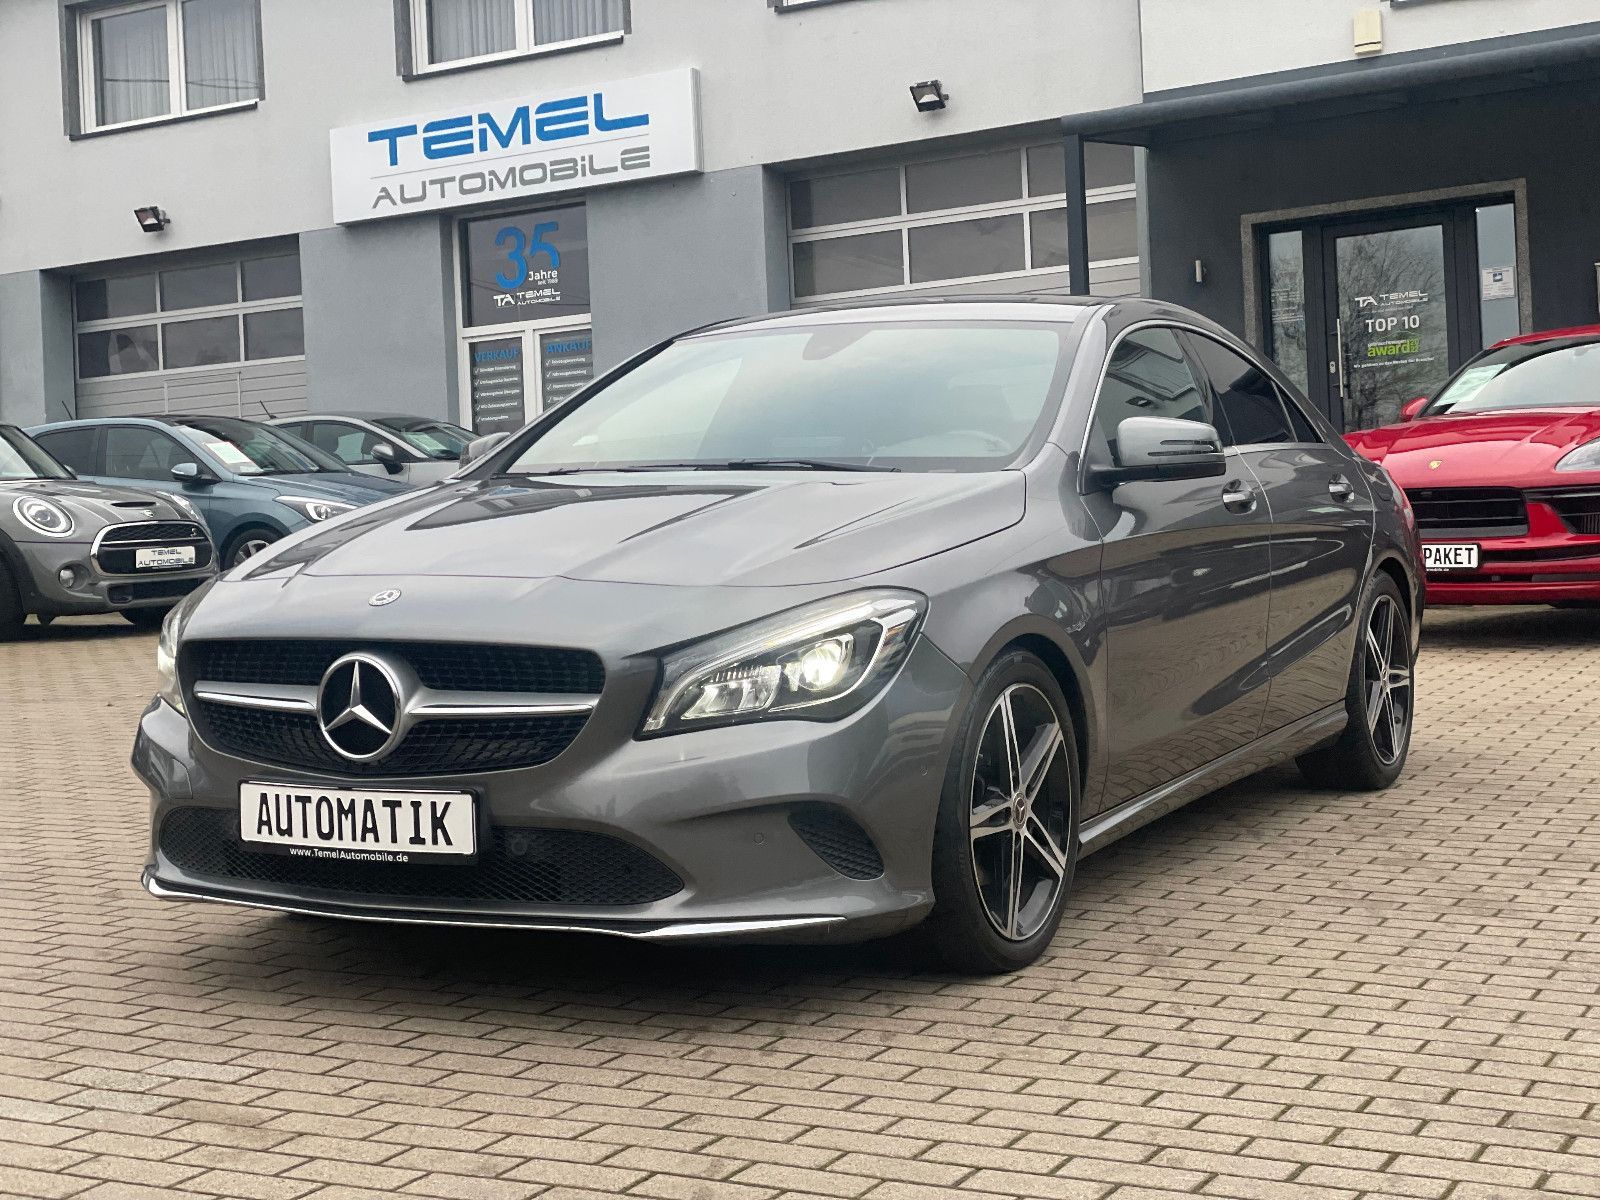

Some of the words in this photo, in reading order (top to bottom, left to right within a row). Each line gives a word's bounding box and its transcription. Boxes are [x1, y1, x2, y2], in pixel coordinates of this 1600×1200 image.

[368, 93, 649, 166] TEMEL
[495, 221, 560, 289] 35
[528, 270, 558, 281] Jahre
[493, 294, 515, 307] TA
[517, 288, 561, 299] TEMEL
[1355, 296, 1378, 307] TA
[1380, 290, 1428, 301] TEMEL
[1366, 317, 1398, 332] TOP
[1401, 314, 1420, 329] 10
[475, 347, 519, 361] VERKAUF
[546, 338, 591, 354] ANKAUF
[1367, 341, 1410, 357] award
[257, 792, 453, 846] AUTOMATIK
[289, 847, 409, 863] www.TemelAutomobile.de
